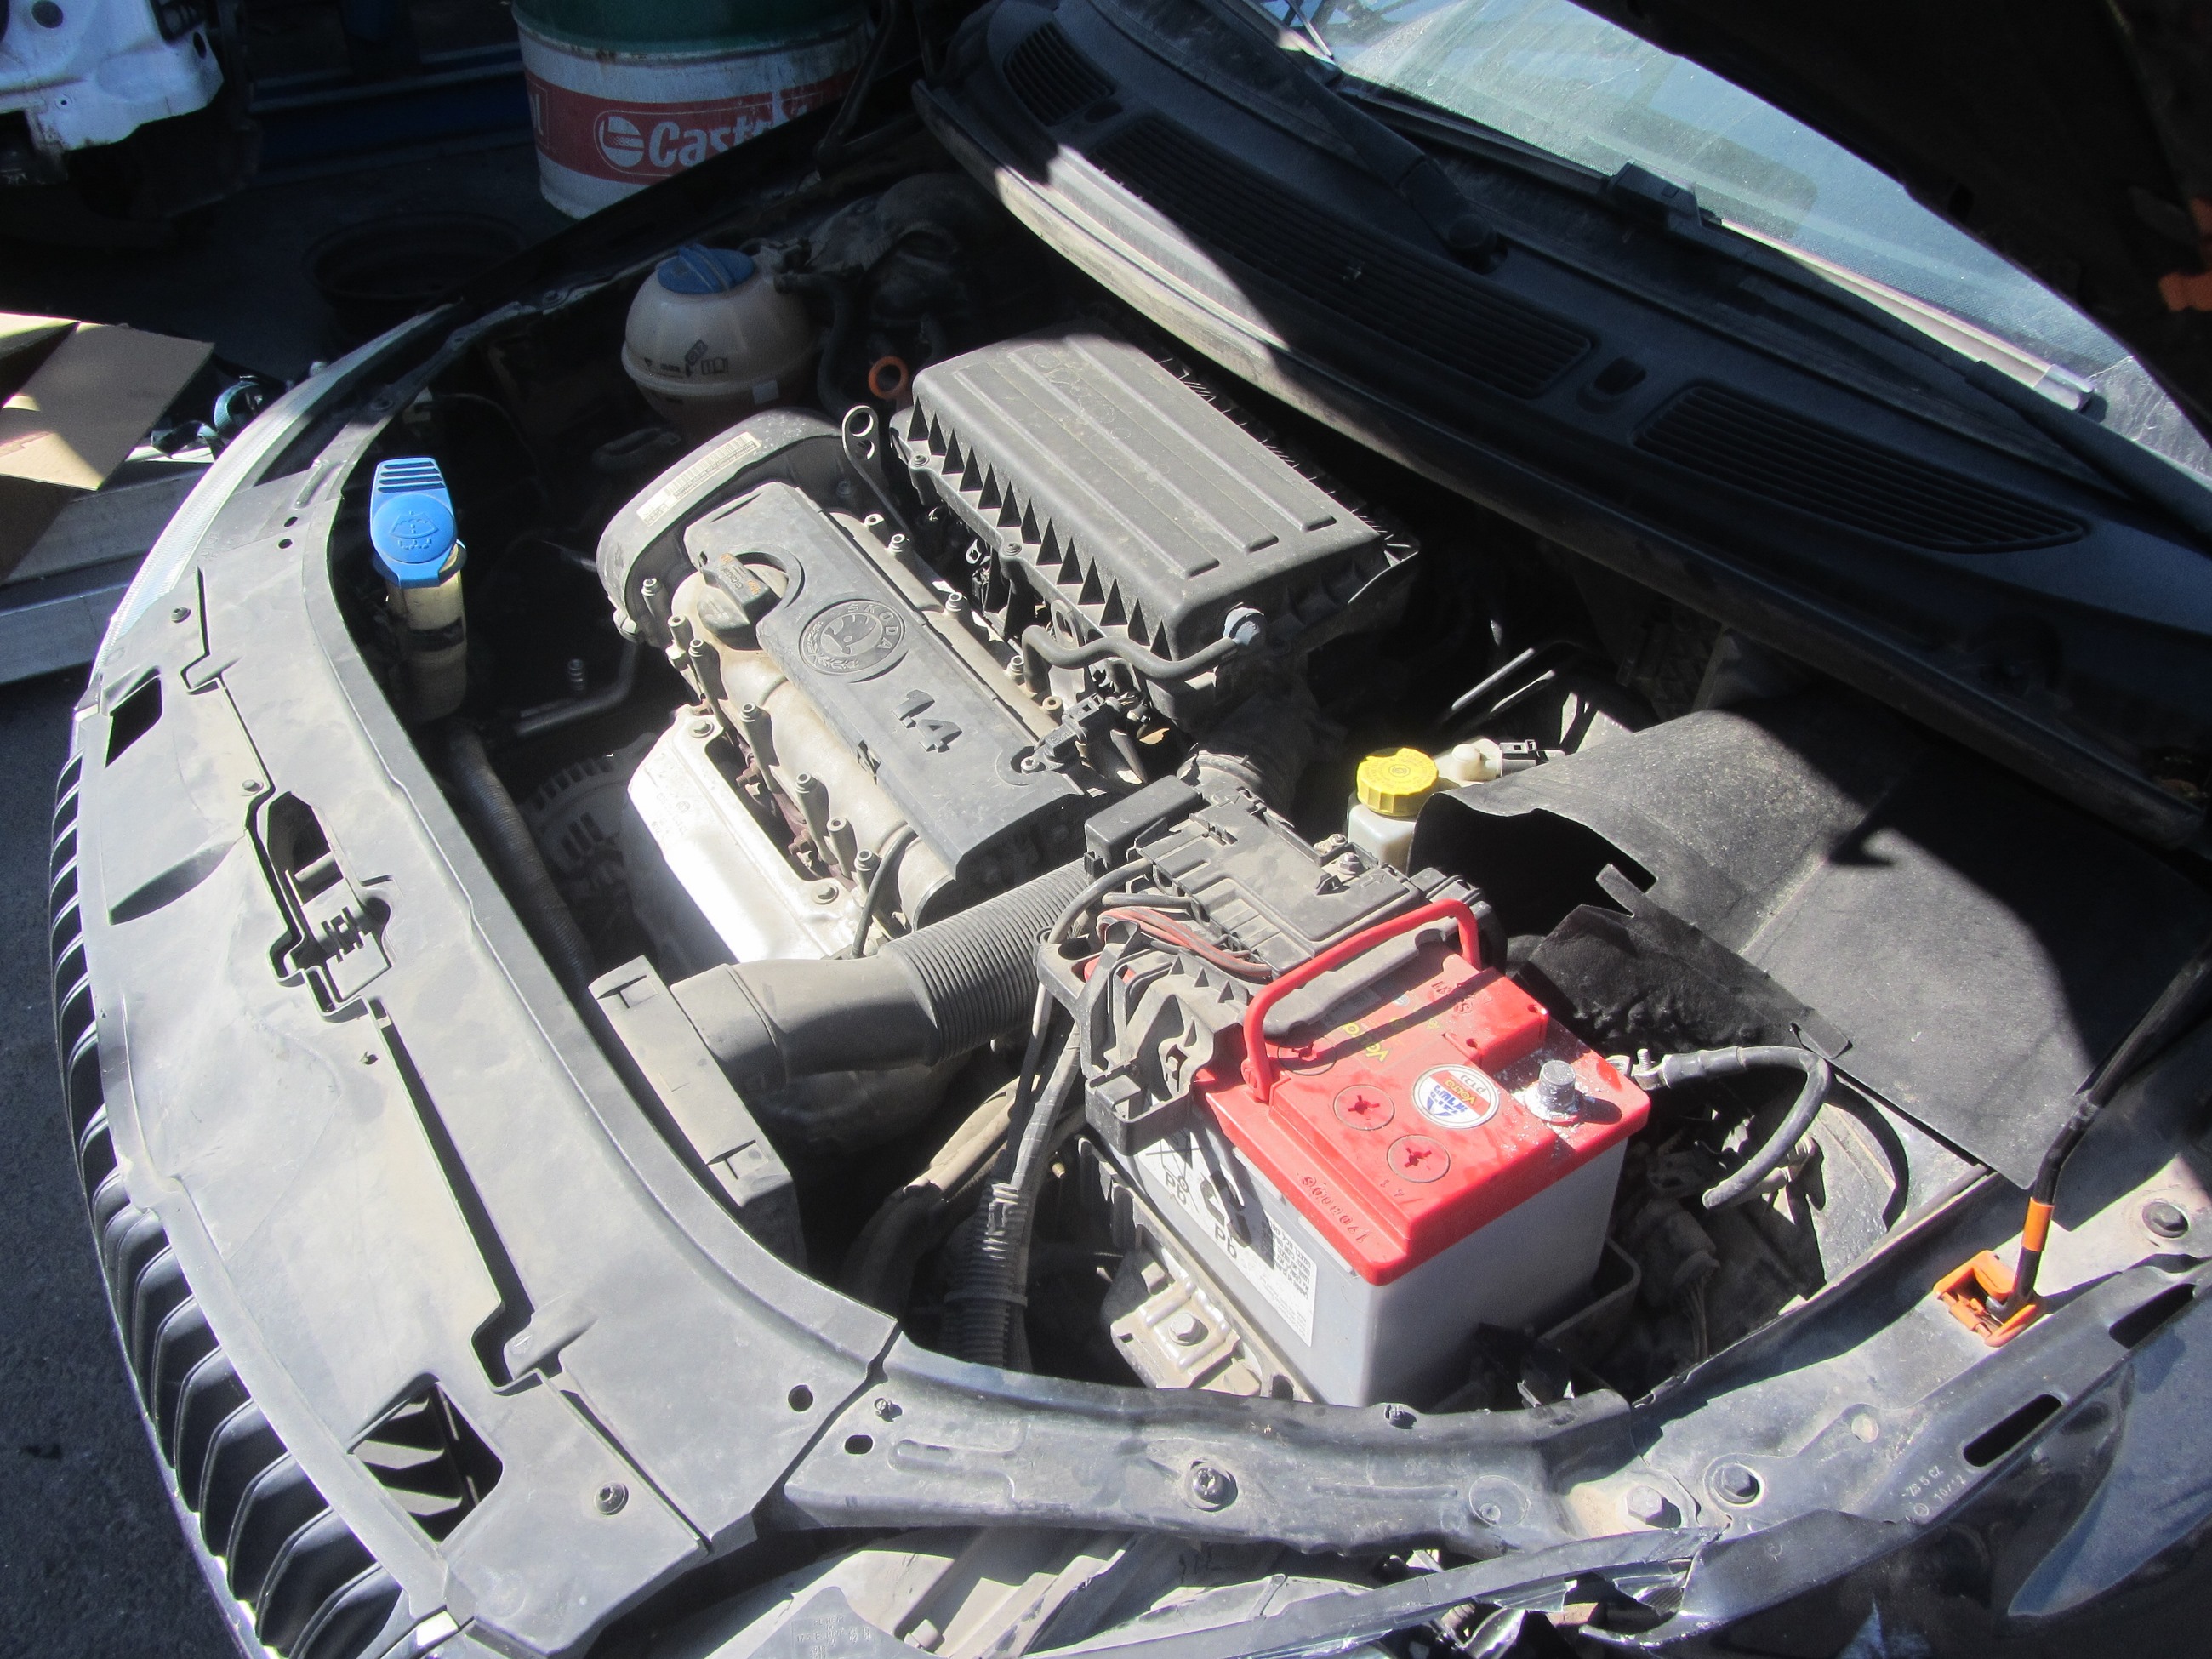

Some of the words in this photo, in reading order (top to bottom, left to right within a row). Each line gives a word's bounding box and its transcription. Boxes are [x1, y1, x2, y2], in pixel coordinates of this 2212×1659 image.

[848, 603, 898, 649] SKODA
[1165, 1172, 1187, 1205] Pb
[1214, 1223, 1237, 1259] Pb
